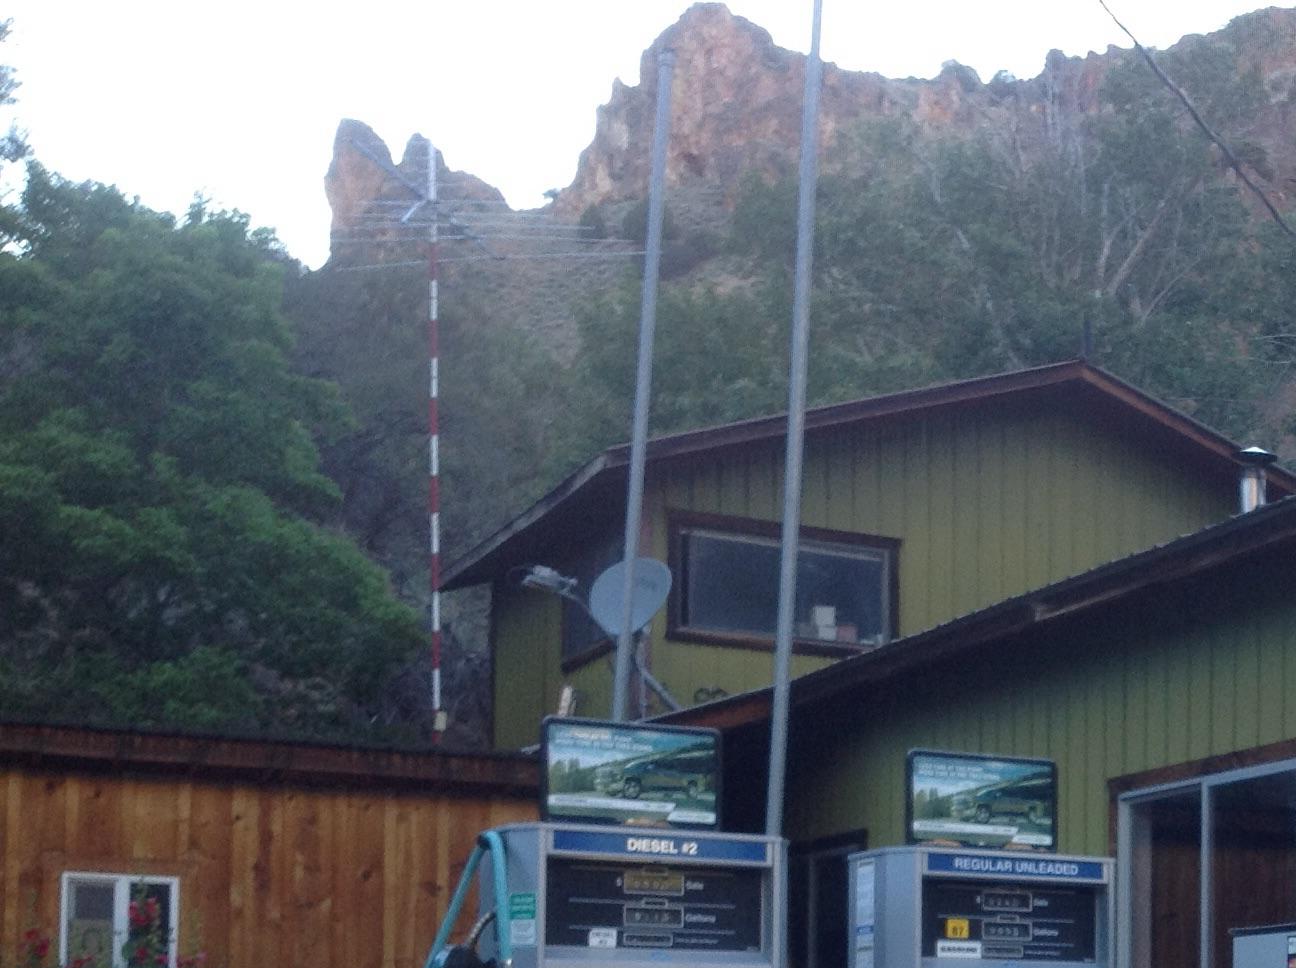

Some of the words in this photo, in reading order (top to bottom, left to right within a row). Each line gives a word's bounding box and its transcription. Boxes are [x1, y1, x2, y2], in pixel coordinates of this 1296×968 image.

[627, 837, 678, 853] DIESEL
[682, 841, 698, 855] #2
[954, 857, 1013, 873] REGULAR
[1015, 860, 1079, 876] UNLEADED
[952, 926, 964, 937] 87
